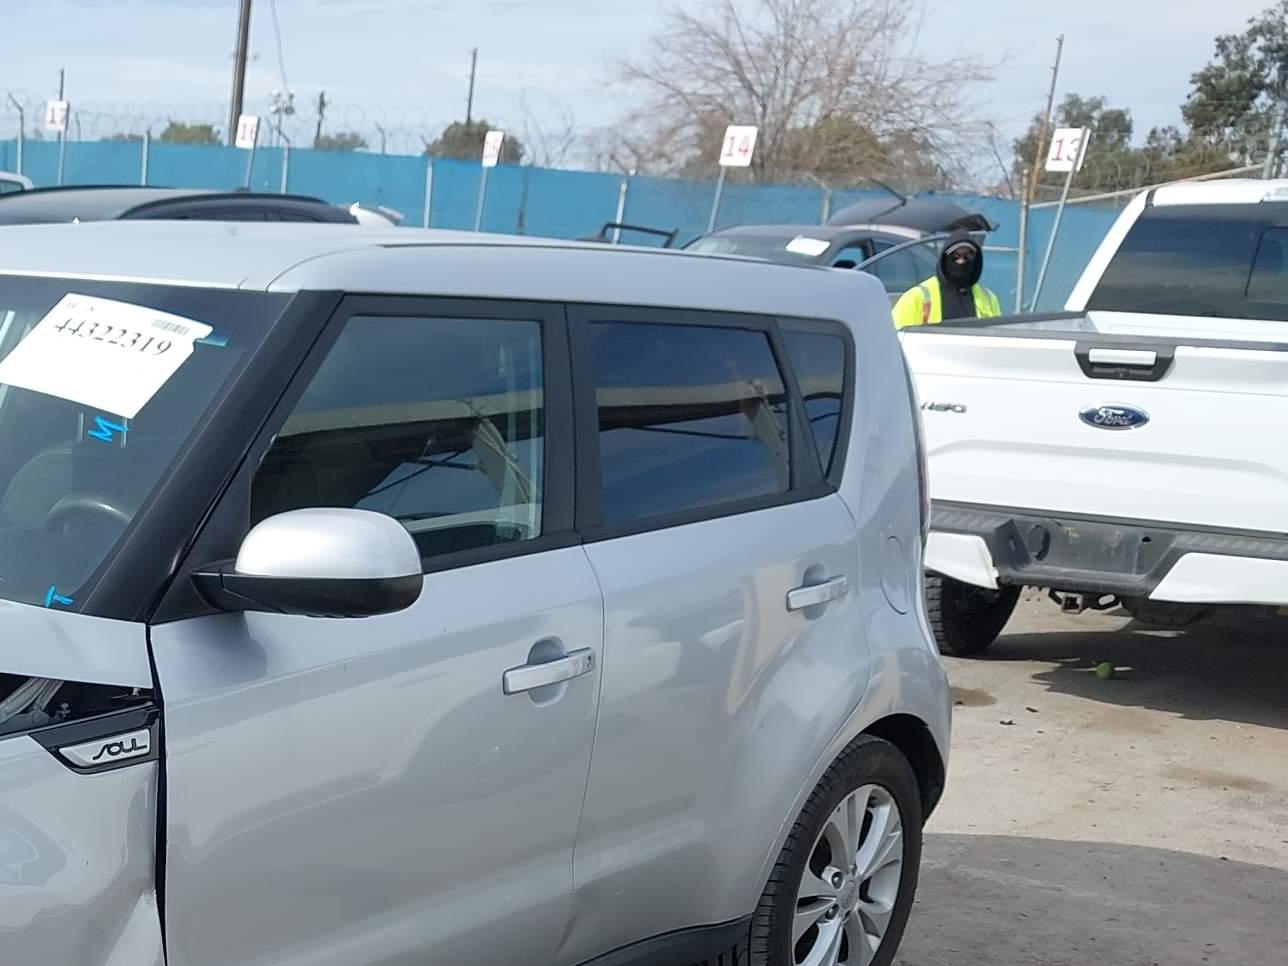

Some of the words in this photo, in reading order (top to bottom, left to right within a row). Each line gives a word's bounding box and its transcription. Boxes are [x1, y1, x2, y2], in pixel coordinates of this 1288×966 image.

[724, 135, 750, 158] 14
[1051, 138, 1081, 161] 13
[54, 318, 172, 356] 44322319
[92, 738, 147, 760] SOUL
